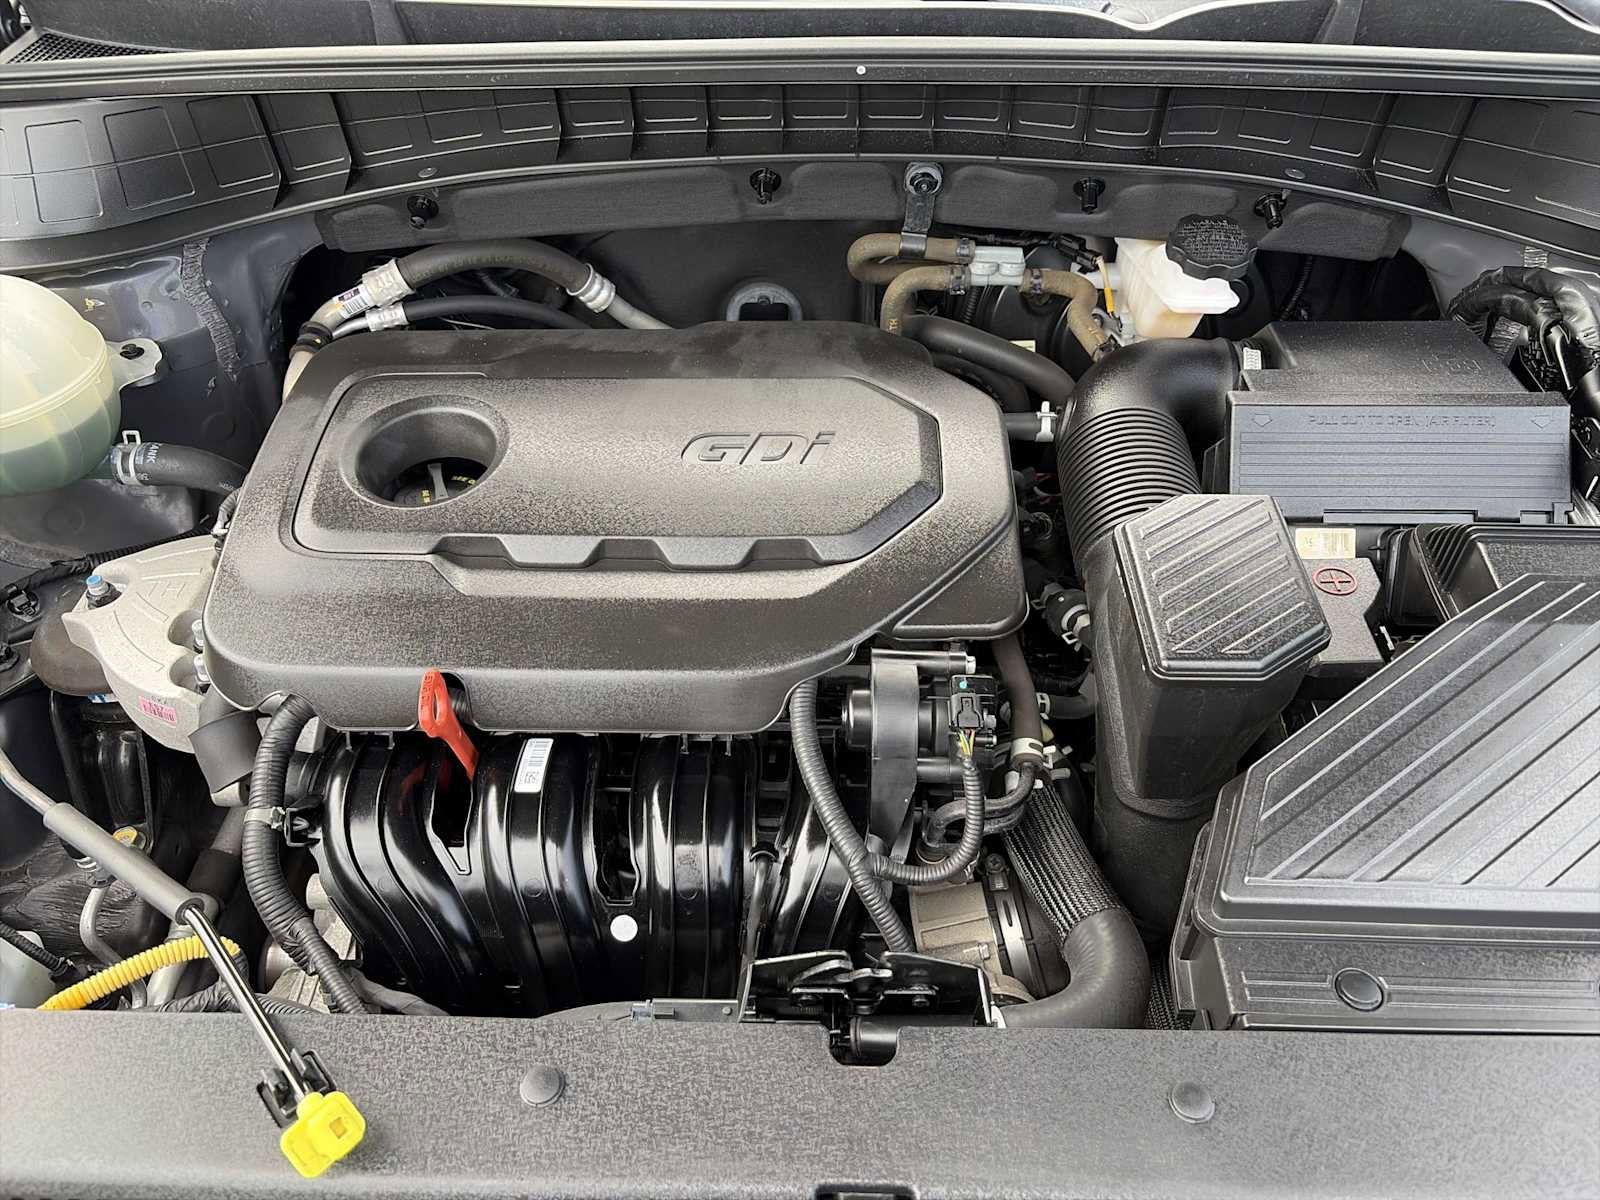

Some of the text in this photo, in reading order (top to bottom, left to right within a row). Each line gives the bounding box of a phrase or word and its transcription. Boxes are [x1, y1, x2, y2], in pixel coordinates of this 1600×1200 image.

[1308, 415, 1338, 426] PULL
[1340, 415, 1365, 426] OUT
[1367, 415, 1385, 426] TO
[1387, 415, 1420, 426] OPEN
[681, 431, 836, 465] GDi
